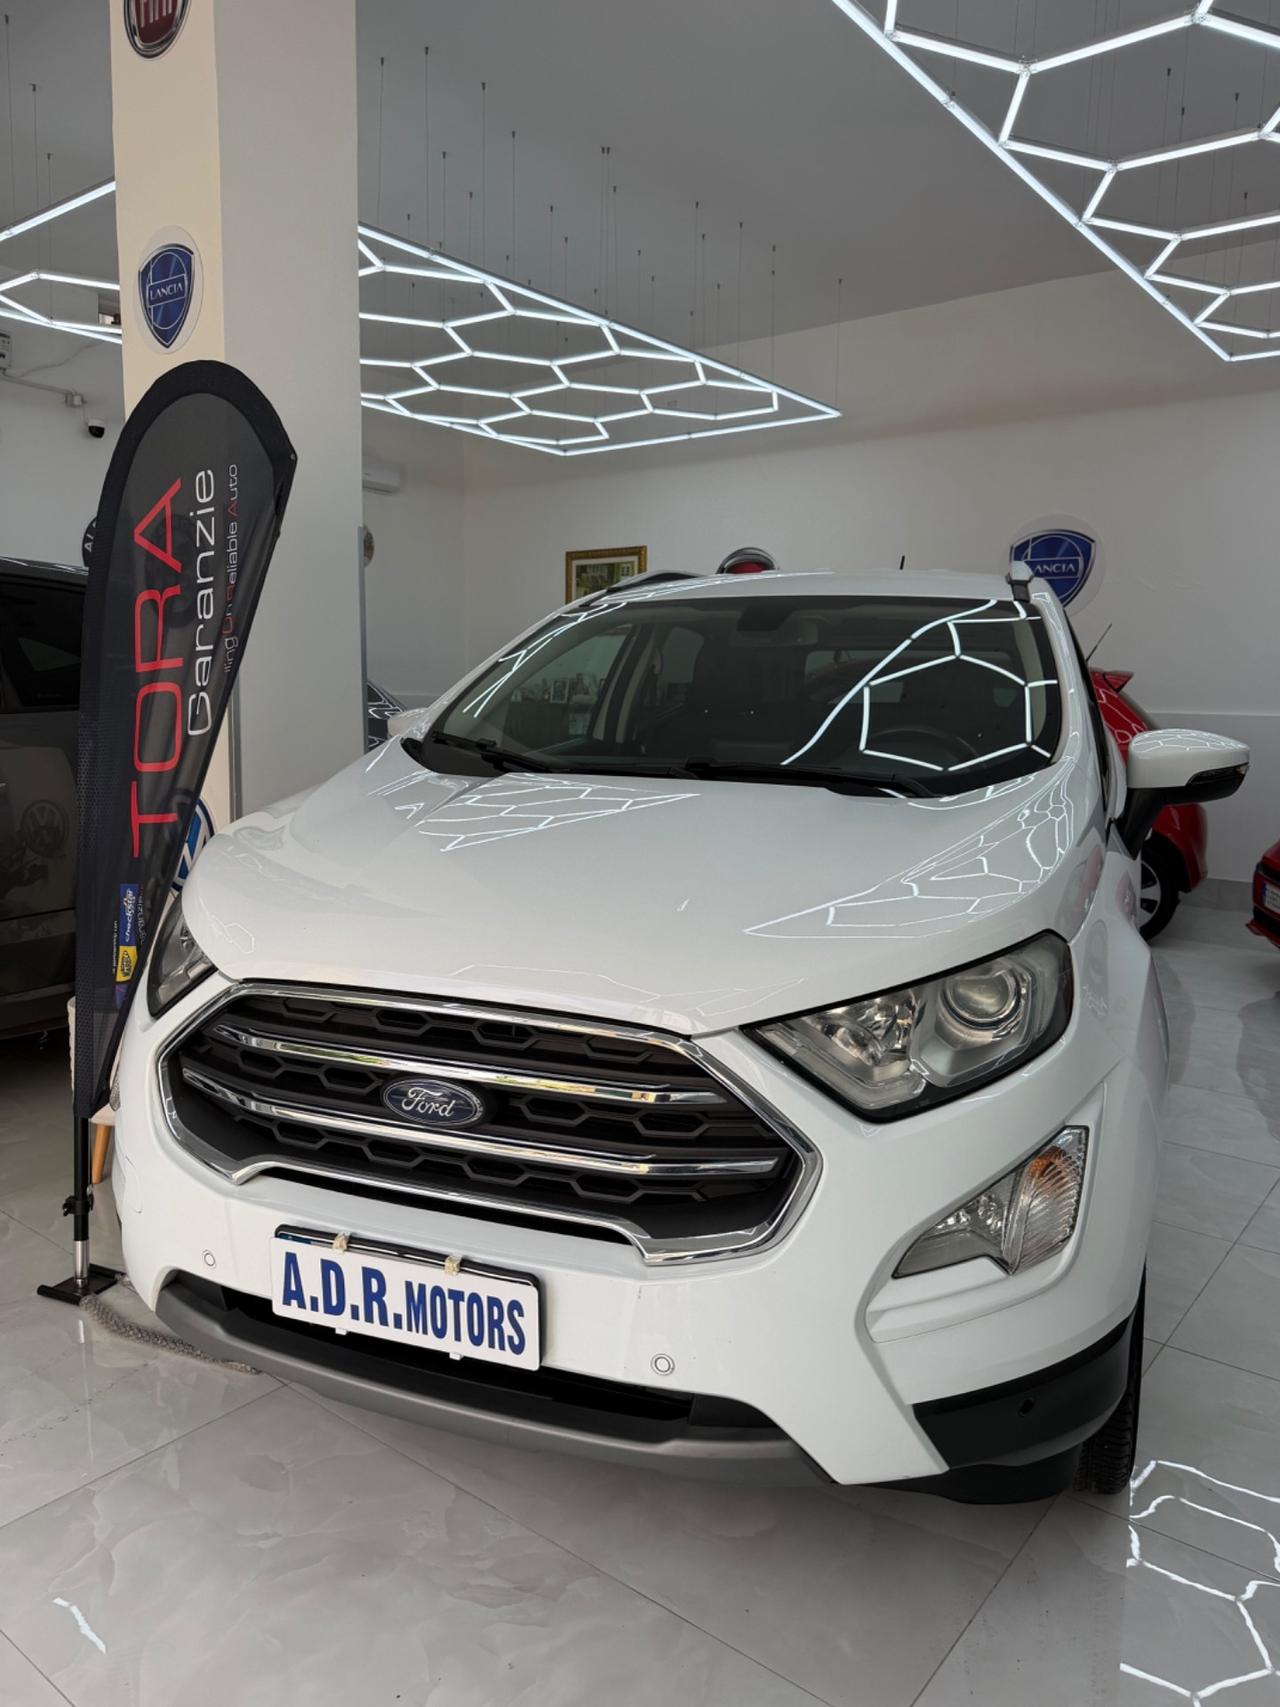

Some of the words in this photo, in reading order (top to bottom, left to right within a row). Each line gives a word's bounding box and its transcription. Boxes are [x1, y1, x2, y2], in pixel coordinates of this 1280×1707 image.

[150, 282, 184, 300] LANCIA
[227, 464, 239, 518] Auto
[1033, 563, 1077, 574] ANCIA
[188, 469, 215, 737] Garanzie
[131, 477, 184, 859] TORA
[401, 1086, 456, 1117] Ford
